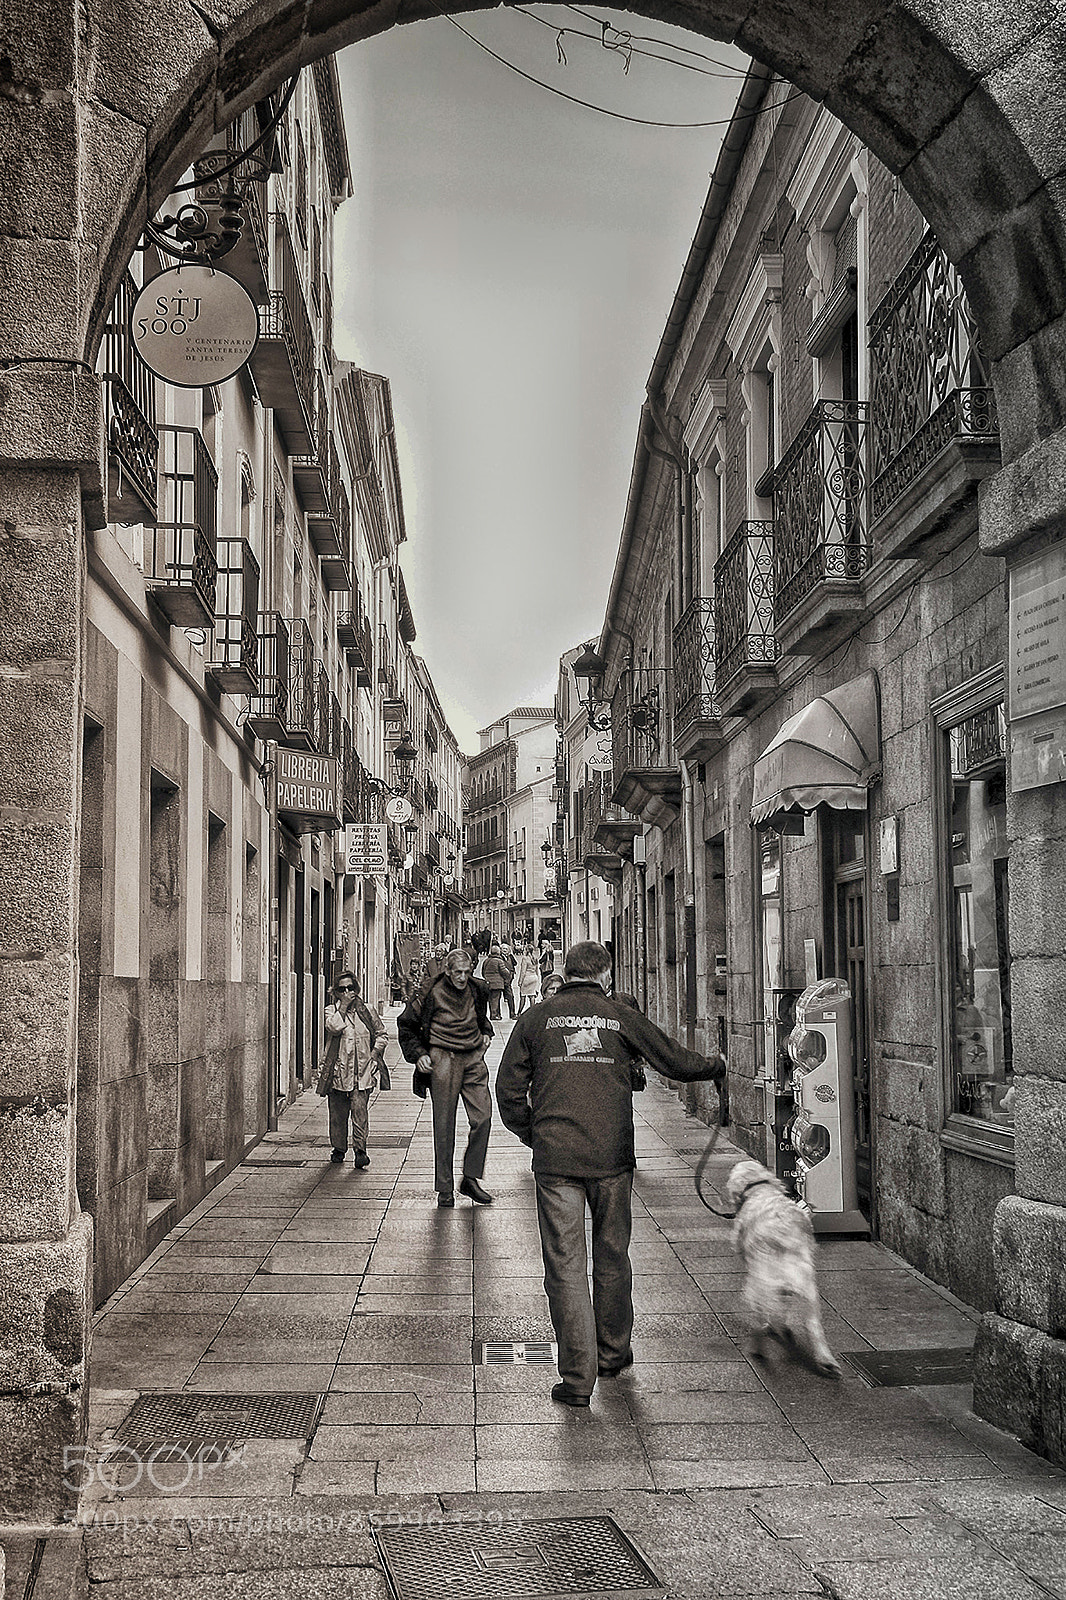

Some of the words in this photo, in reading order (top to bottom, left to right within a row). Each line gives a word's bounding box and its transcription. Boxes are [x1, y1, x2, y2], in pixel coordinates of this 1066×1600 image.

[155, 292, 202, 322] STJ
[138, 318, 187, 340] 500
[281, 753, 330, 784] LIBRERIA
[277, 781, 334, 812] PAPELERIA
[546, 1015, 606, 1029] ASOCIACIÓN
